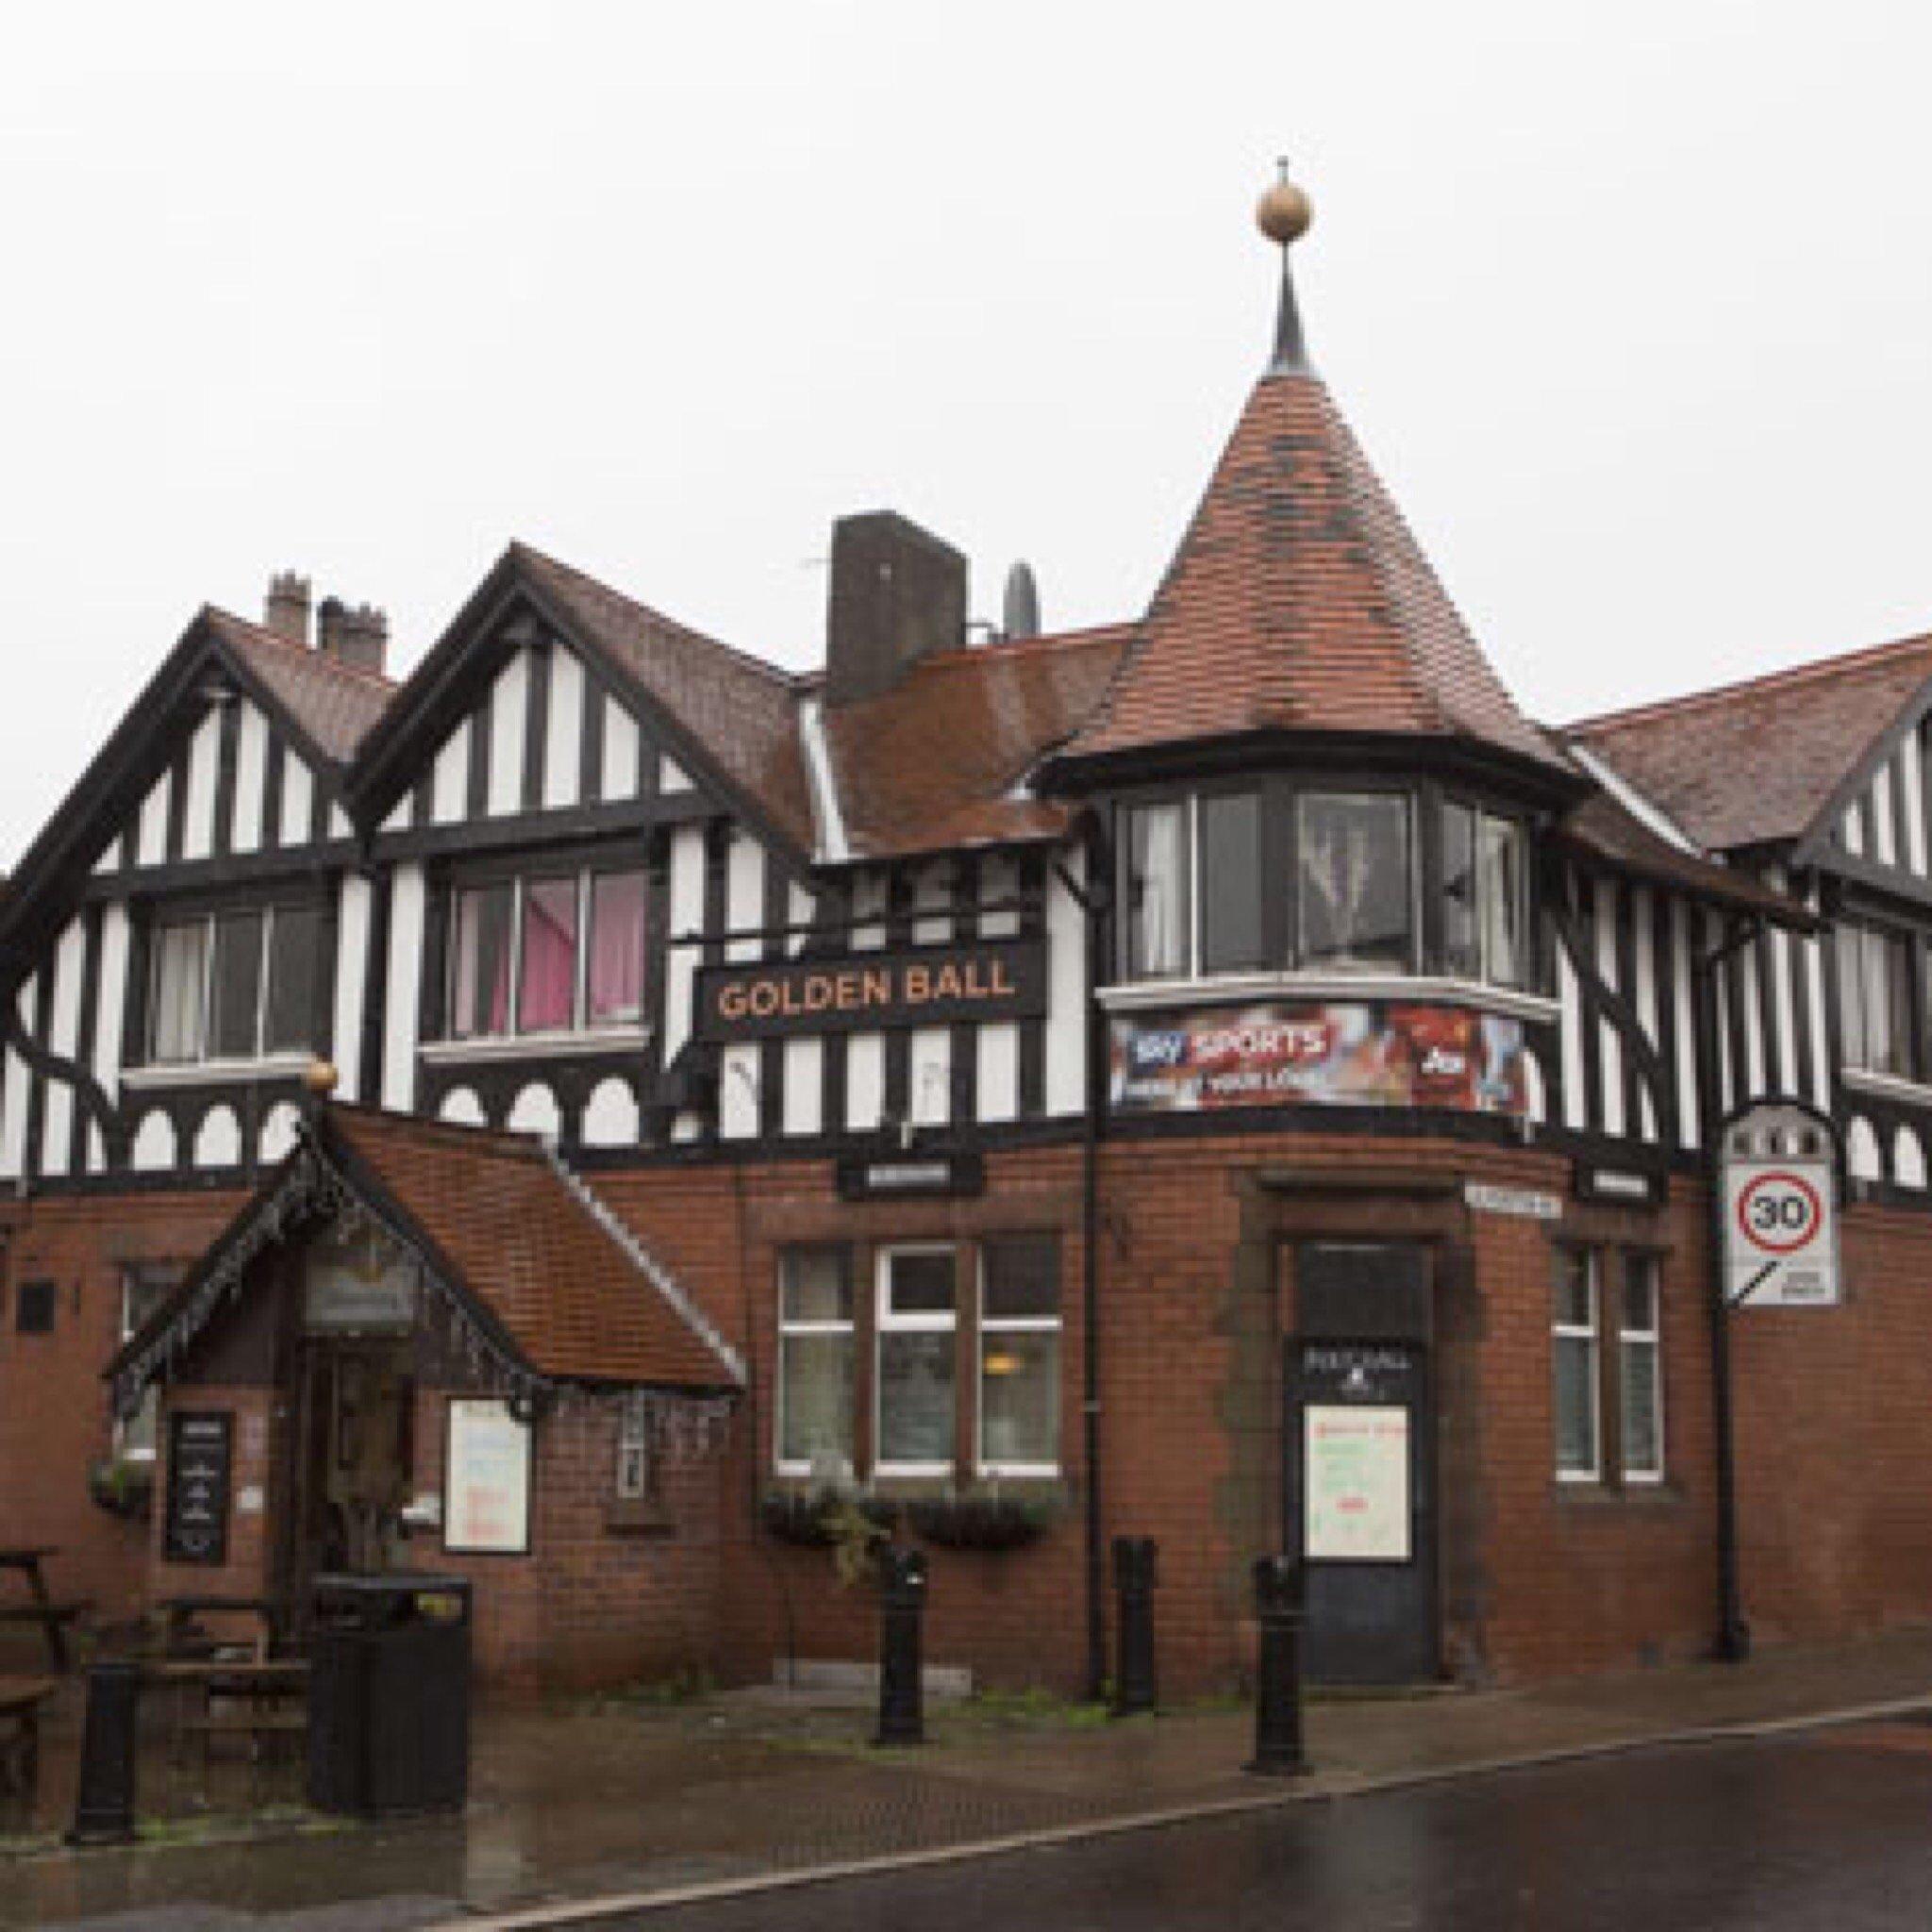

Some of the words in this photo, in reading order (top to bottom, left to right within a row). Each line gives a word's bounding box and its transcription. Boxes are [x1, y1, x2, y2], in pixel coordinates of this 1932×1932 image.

[718, 969, 891, 1020] GOLDEN
[905, 958, 1016, 1004] BALL
[1191, 1024, 1326, 1061] SPORTS
[1754, 1196, 1809, 1228] 30
